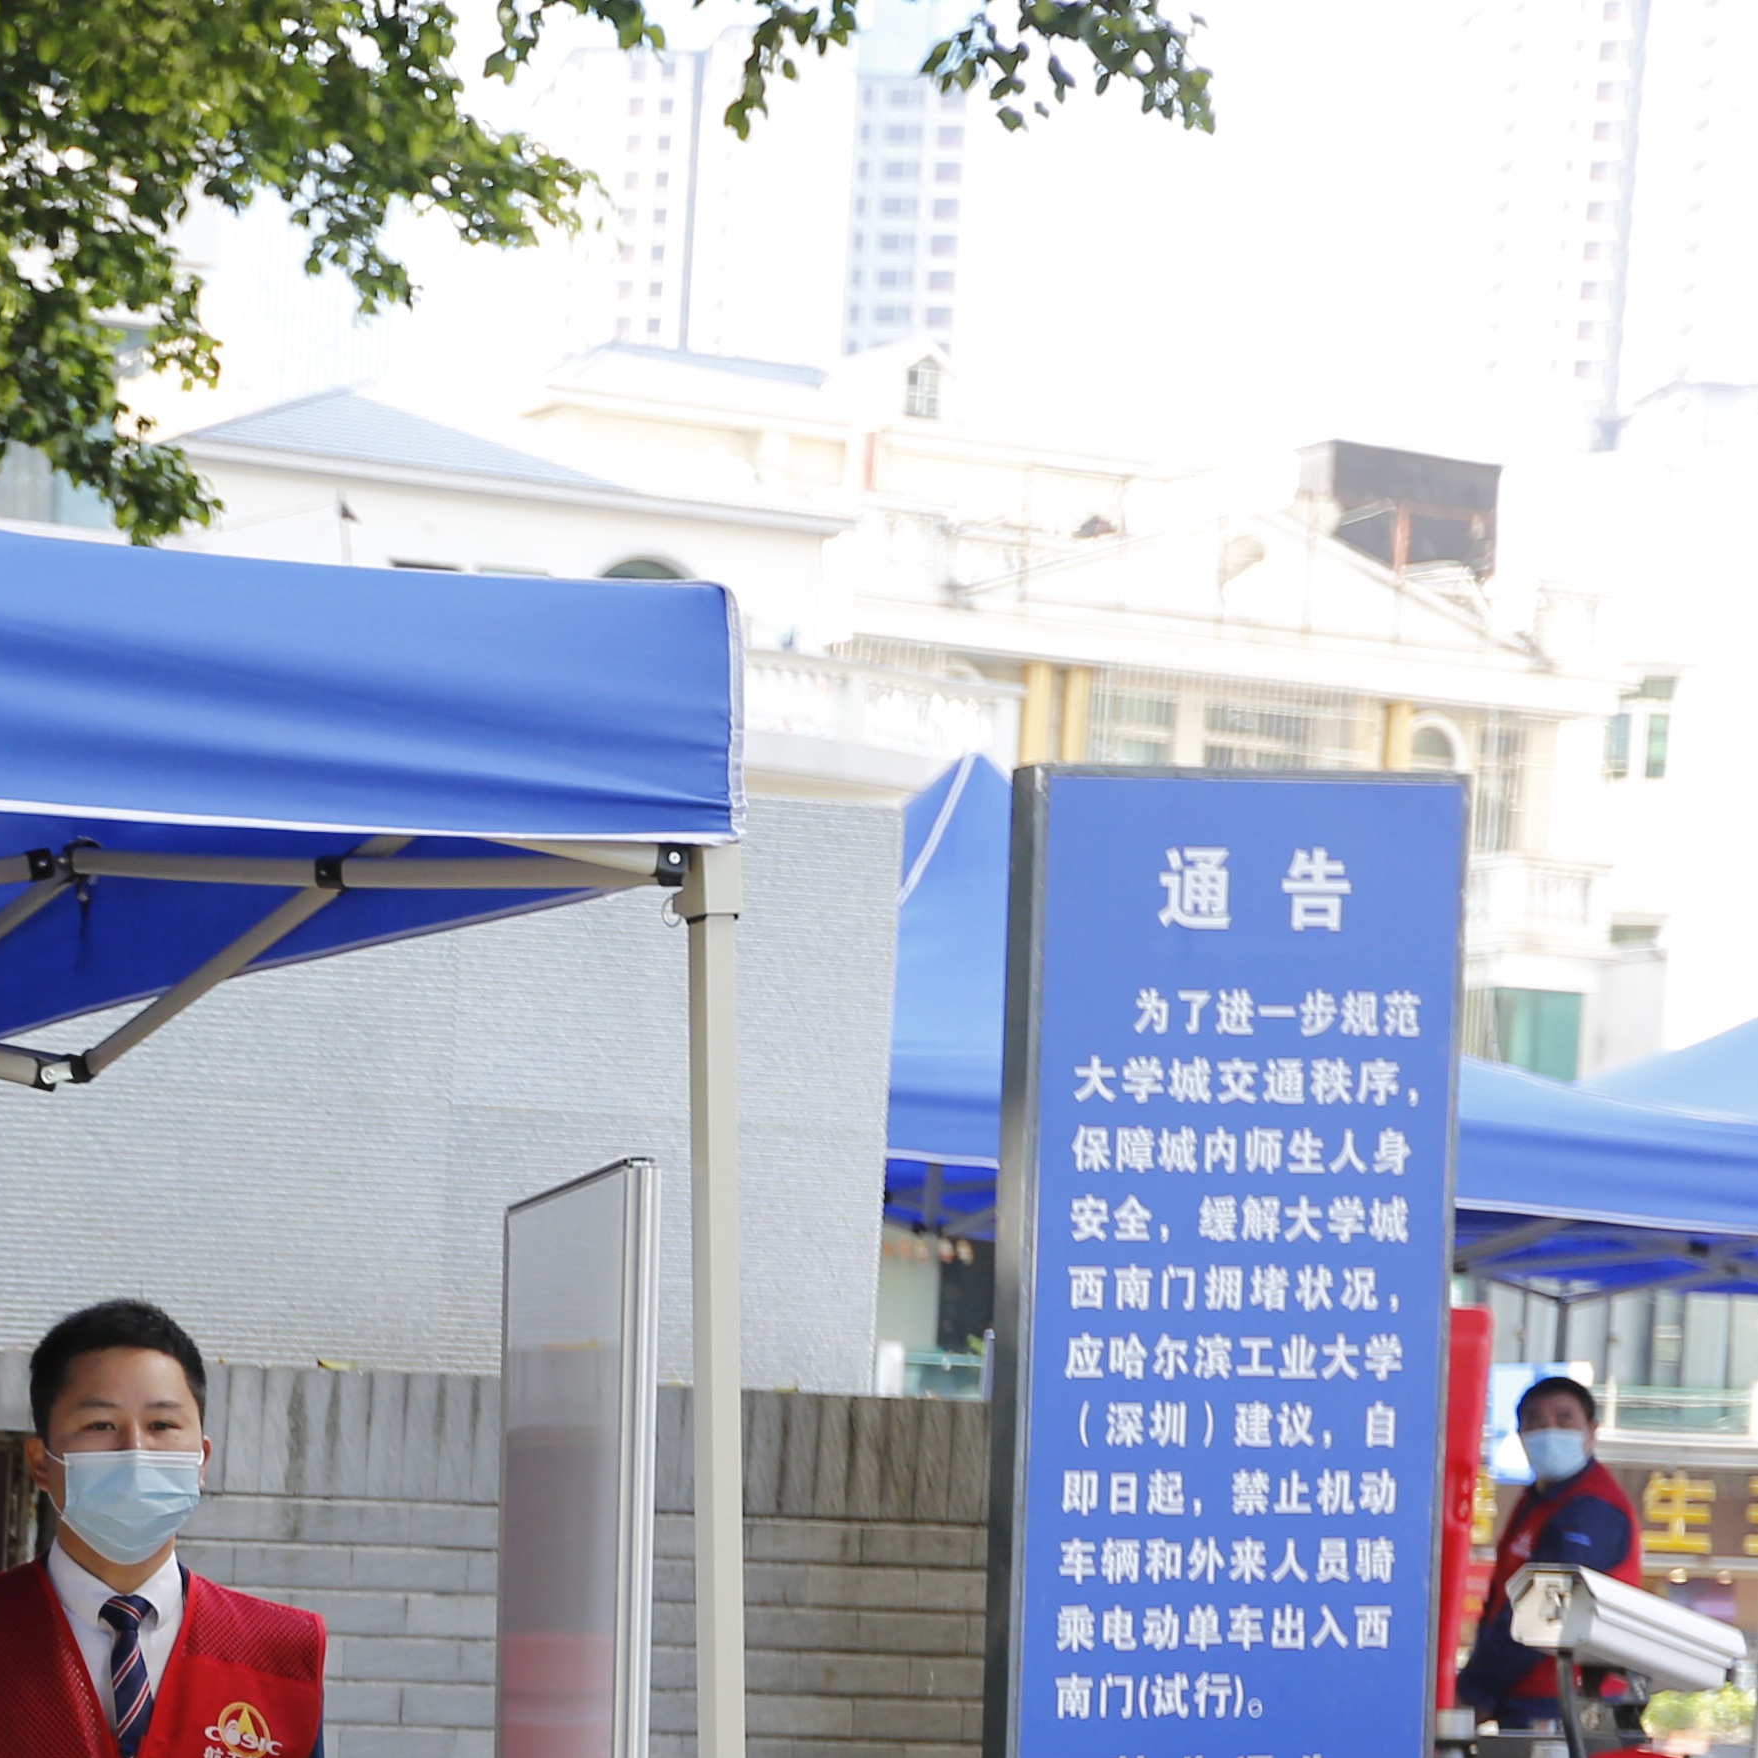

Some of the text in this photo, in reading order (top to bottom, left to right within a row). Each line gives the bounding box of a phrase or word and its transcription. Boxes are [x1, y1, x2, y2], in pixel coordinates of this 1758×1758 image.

[1158, 847, 1352, 932] 通告
[1134, 987, 1421, 1038] 为了进一步规范
[1074, 1055, 1419, 1107] 大学城交通秩序，
[1071, 1125, 1412, 1176] 保障城内师生人身
[1070, 1194, 1409, 1244] 安全，缓解大学城
[1068, 1263, 1399, 1313] 西南门拥堵状况，
[1064, 1332, 1403, 1381] 应哈尔滨工业大学
[1079, 1400, 1396, 1449] （深圳）建议，自
[1062, 1468, 1397, 1517] 即日起，禁止机动
[1059, 1536, 1395, 1584] 车辆和外来人员骑
[1057, 1604, 1392, 1653] 乘电动单车出入西
